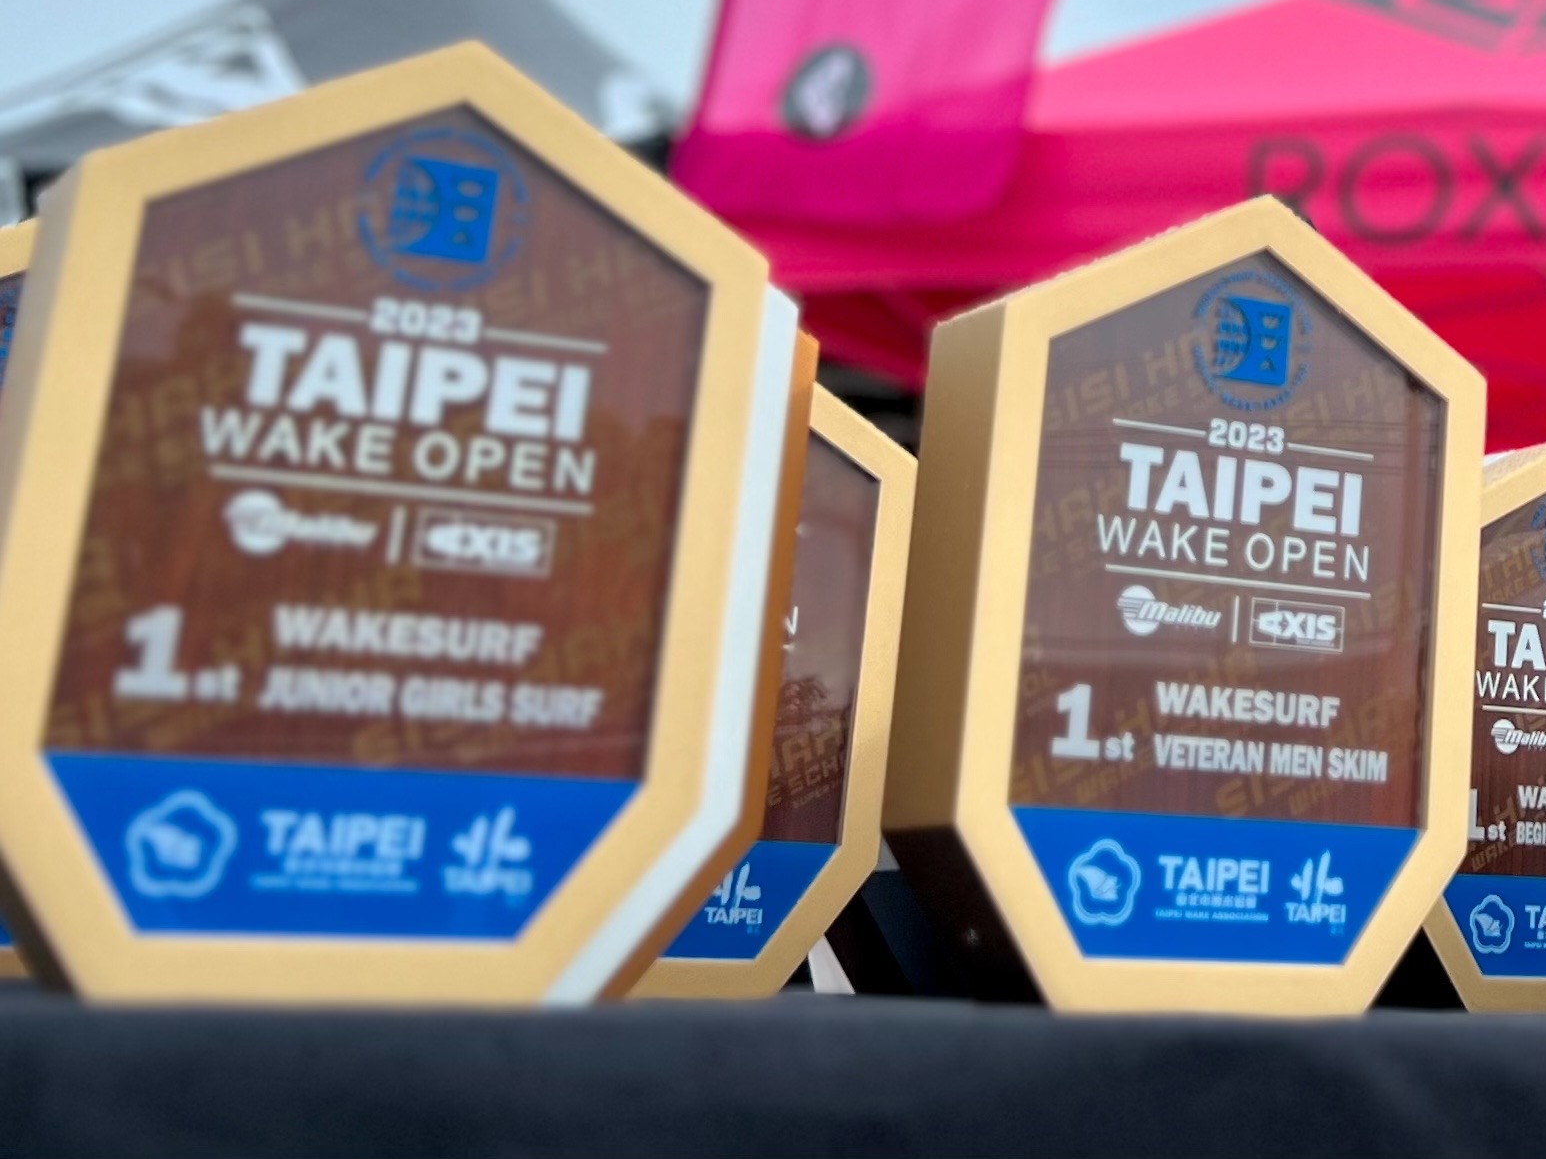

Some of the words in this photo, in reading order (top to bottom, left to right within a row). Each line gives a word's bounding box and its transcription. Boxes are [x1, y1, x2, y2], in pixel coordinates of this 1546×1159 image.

[370, 298, 484, 343] 2023
[239, 323, 592, 441] TAIPEI
[202, 406, 395, 475] WAKE
[412, 430, 596, 495] OPEN
[1208, 417, 1286, 455] 2023
[1119, 441, 1364, 537] TAIPEI
[1097, 513, 1231, 568] WAKE
[1244, 531, 1370, 583] OPEN
[273, 604, 543, 666] WAKESURF
[259, 667, 396, 717] JUNIOR
[400, 675, 504, 725] GIRLS
[509, 684, 603, 730] SURF
[1155, 680, 1341, 729] WAKESURF
[1154, 733, 1266, 774] VETERAN
[1269, 741, 1324, 778] MEN
[1327, 746, 1389, 783] SKIM
[261, 809, 427, 861] TAIPEI
[1158, 854, 1271, 894] TAIPEI
[1285, 901, 1347, 924] TAIPEI
